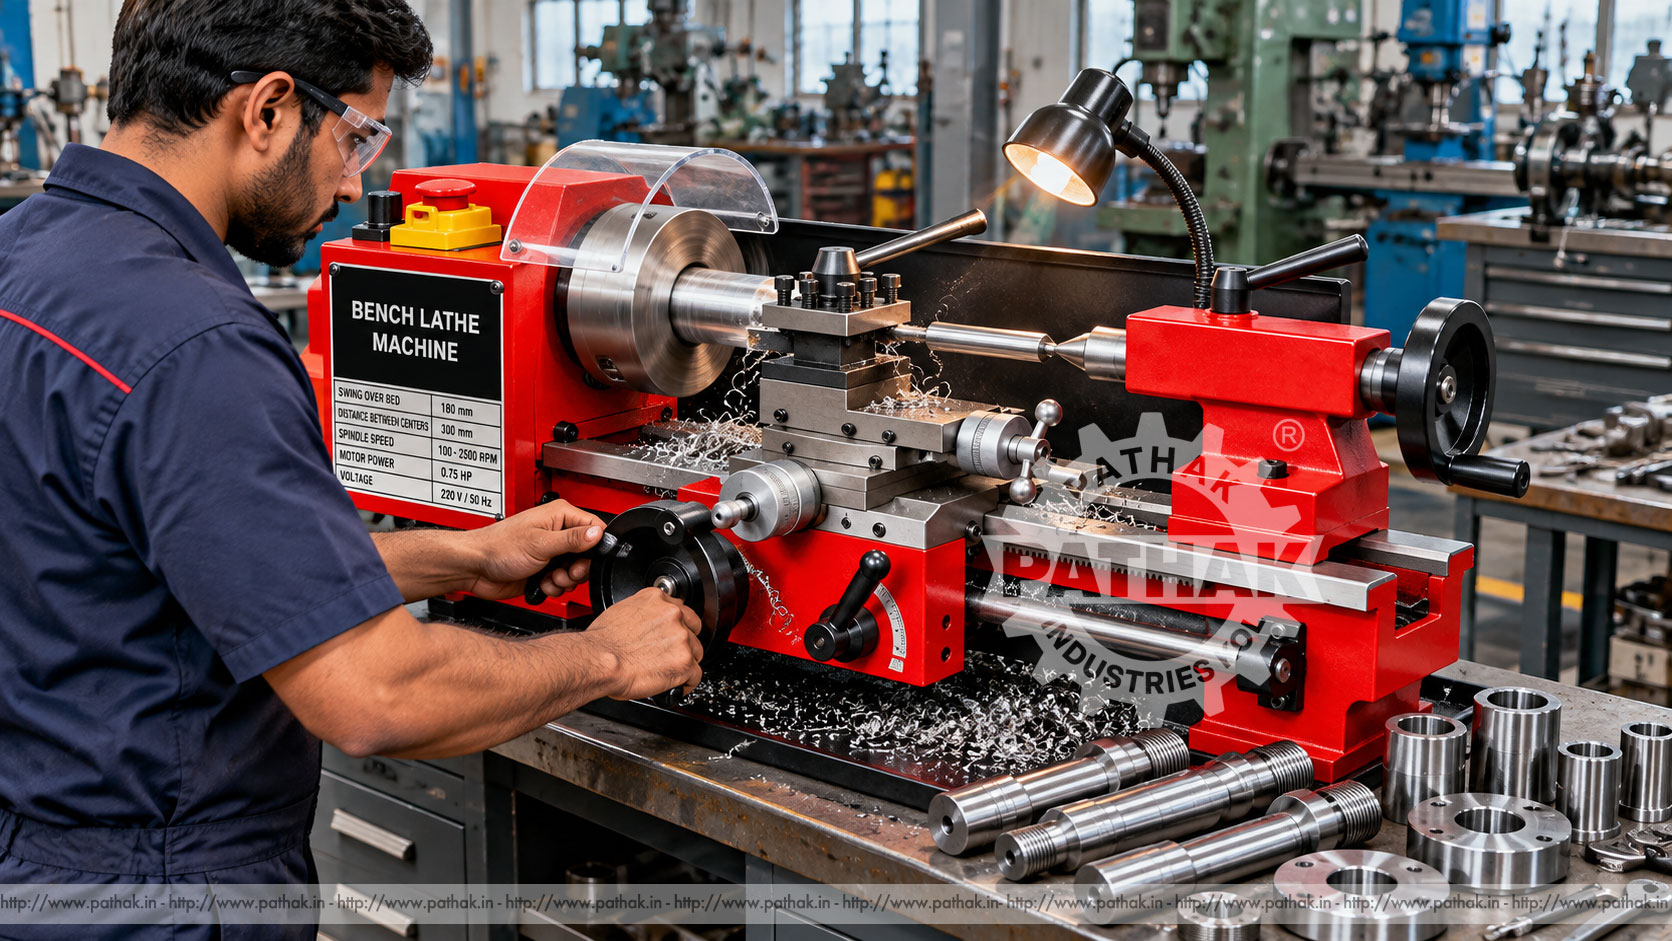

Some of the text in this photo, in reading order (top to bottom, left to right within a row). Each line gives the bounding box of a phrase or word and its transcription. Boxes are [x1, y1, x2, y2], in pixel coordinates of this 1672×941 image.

[352, 300, 480, 334] BENCH LATHE
[372, 332, 458, 362] MACHINE
[338, 387, 401, 406] SWING OVER BED
[441, 402, 473, 417] 180 mm
[400, 417, 429, 432] CENTERS
[441, 423, 473, 438] 300 mm
[338, 428, 395, 447] SPINDLE SPEED
[339, 449, 395, 469] MOTOR POWER
[438, 444, 452, 457] 100
[458, 448, 478, 461] 2500
[479, 452, 498, 464] RPM
[339, 469, 373, 486] VOLTAGE
[441, 466, 472, 481] 0.75 HP
[441, 488, 455, 501] 220
[456, 491, 462, 502] V
[469, 493, 480, 505] 50
[481, 496, 492, 507] Hz
